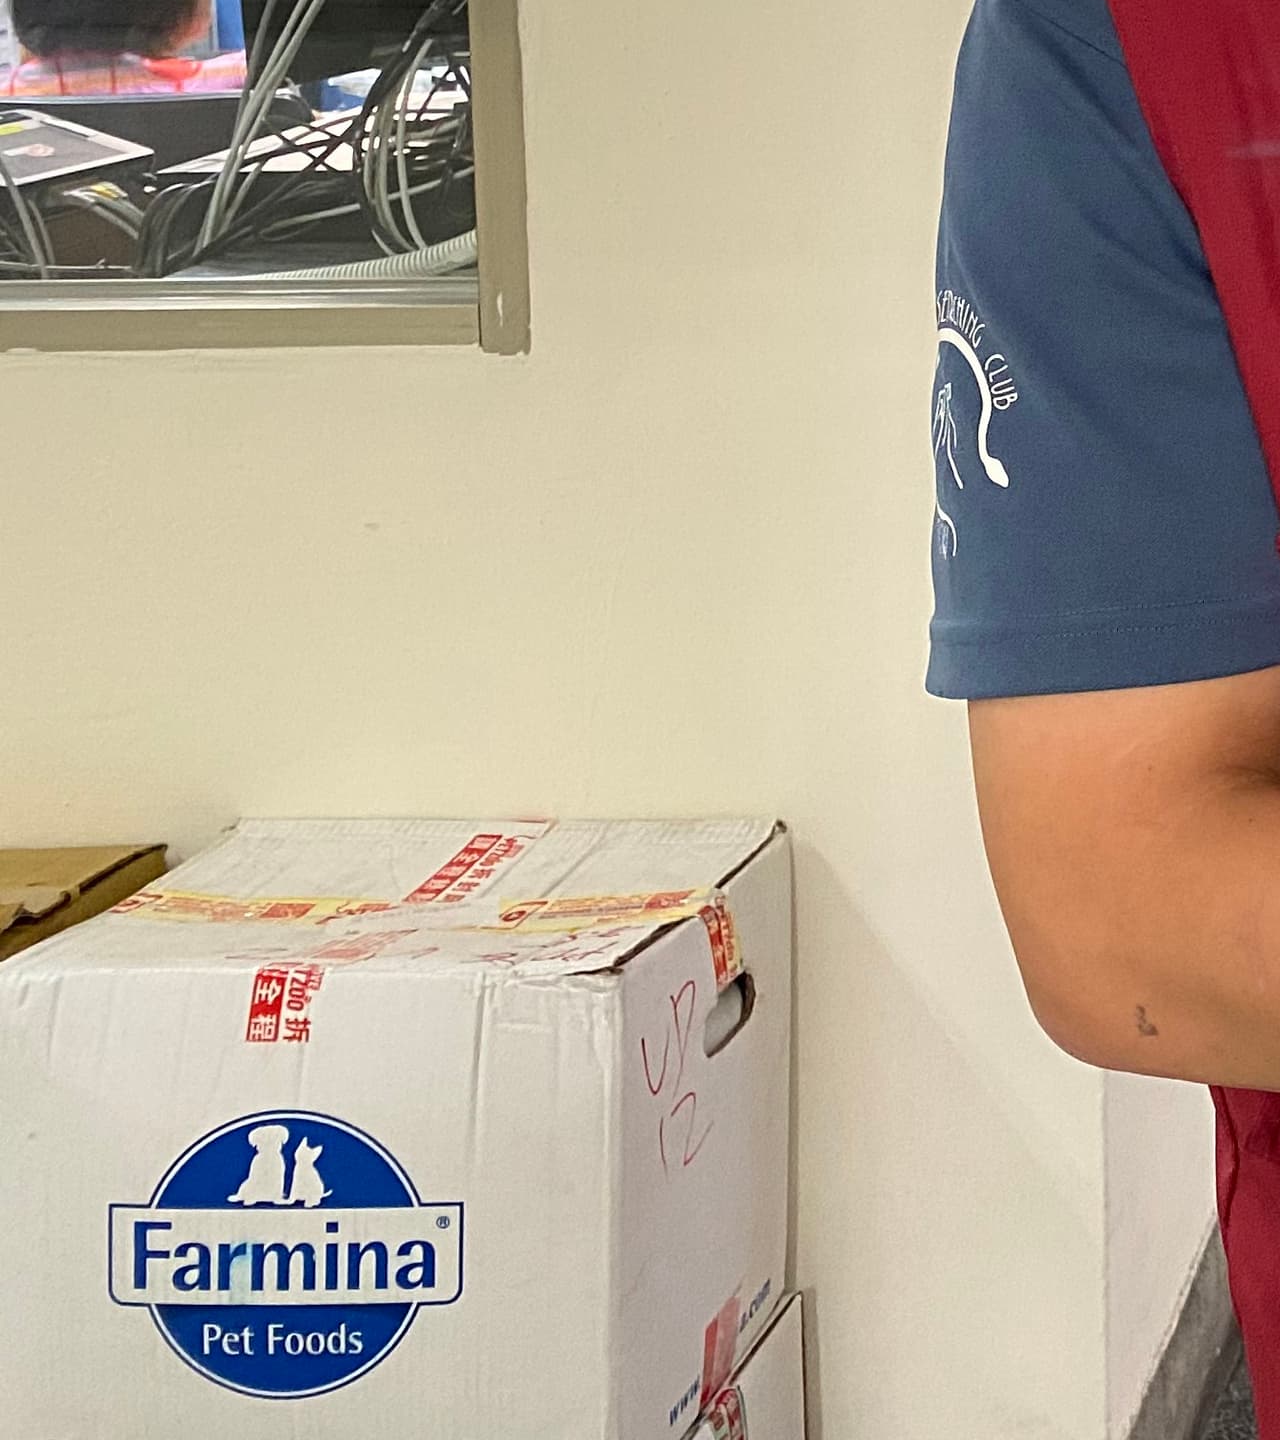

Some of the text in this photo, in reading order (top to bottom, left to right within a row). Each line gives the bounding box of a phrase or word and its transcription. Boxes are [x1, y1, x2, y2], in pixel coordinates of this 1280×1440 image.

[985, 353, 1018, 410] CLUB
[249, 970, 282, 1041] 全程
[132, 1220, 437, 1291] Farmina
[201, 1322, 364, 1356] Pet Foods
